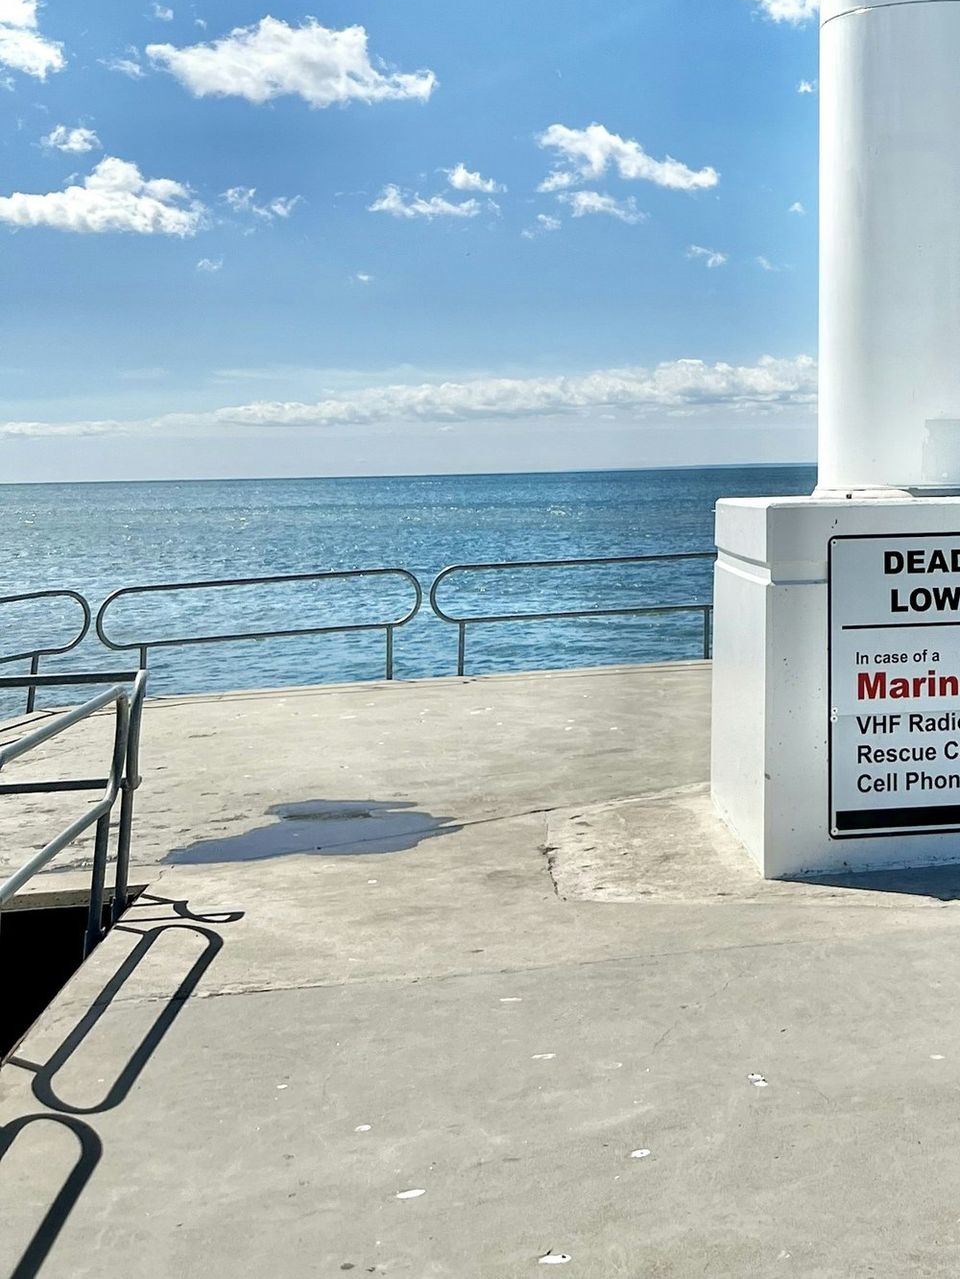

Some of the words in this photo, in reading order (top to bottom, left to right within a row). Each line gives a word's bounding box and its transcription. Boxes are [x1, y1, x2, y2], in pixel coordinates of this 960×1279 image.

[855, 651, 870, 665] In
[873, 652, 909, 665] case
[913, 649, 928, 663] of
[931, 652, 941, 663] a
[856, 714, 902, 735] VHF
[856, 743, 938, 765] Rescue
[856, 772, 898, 794] Cell
